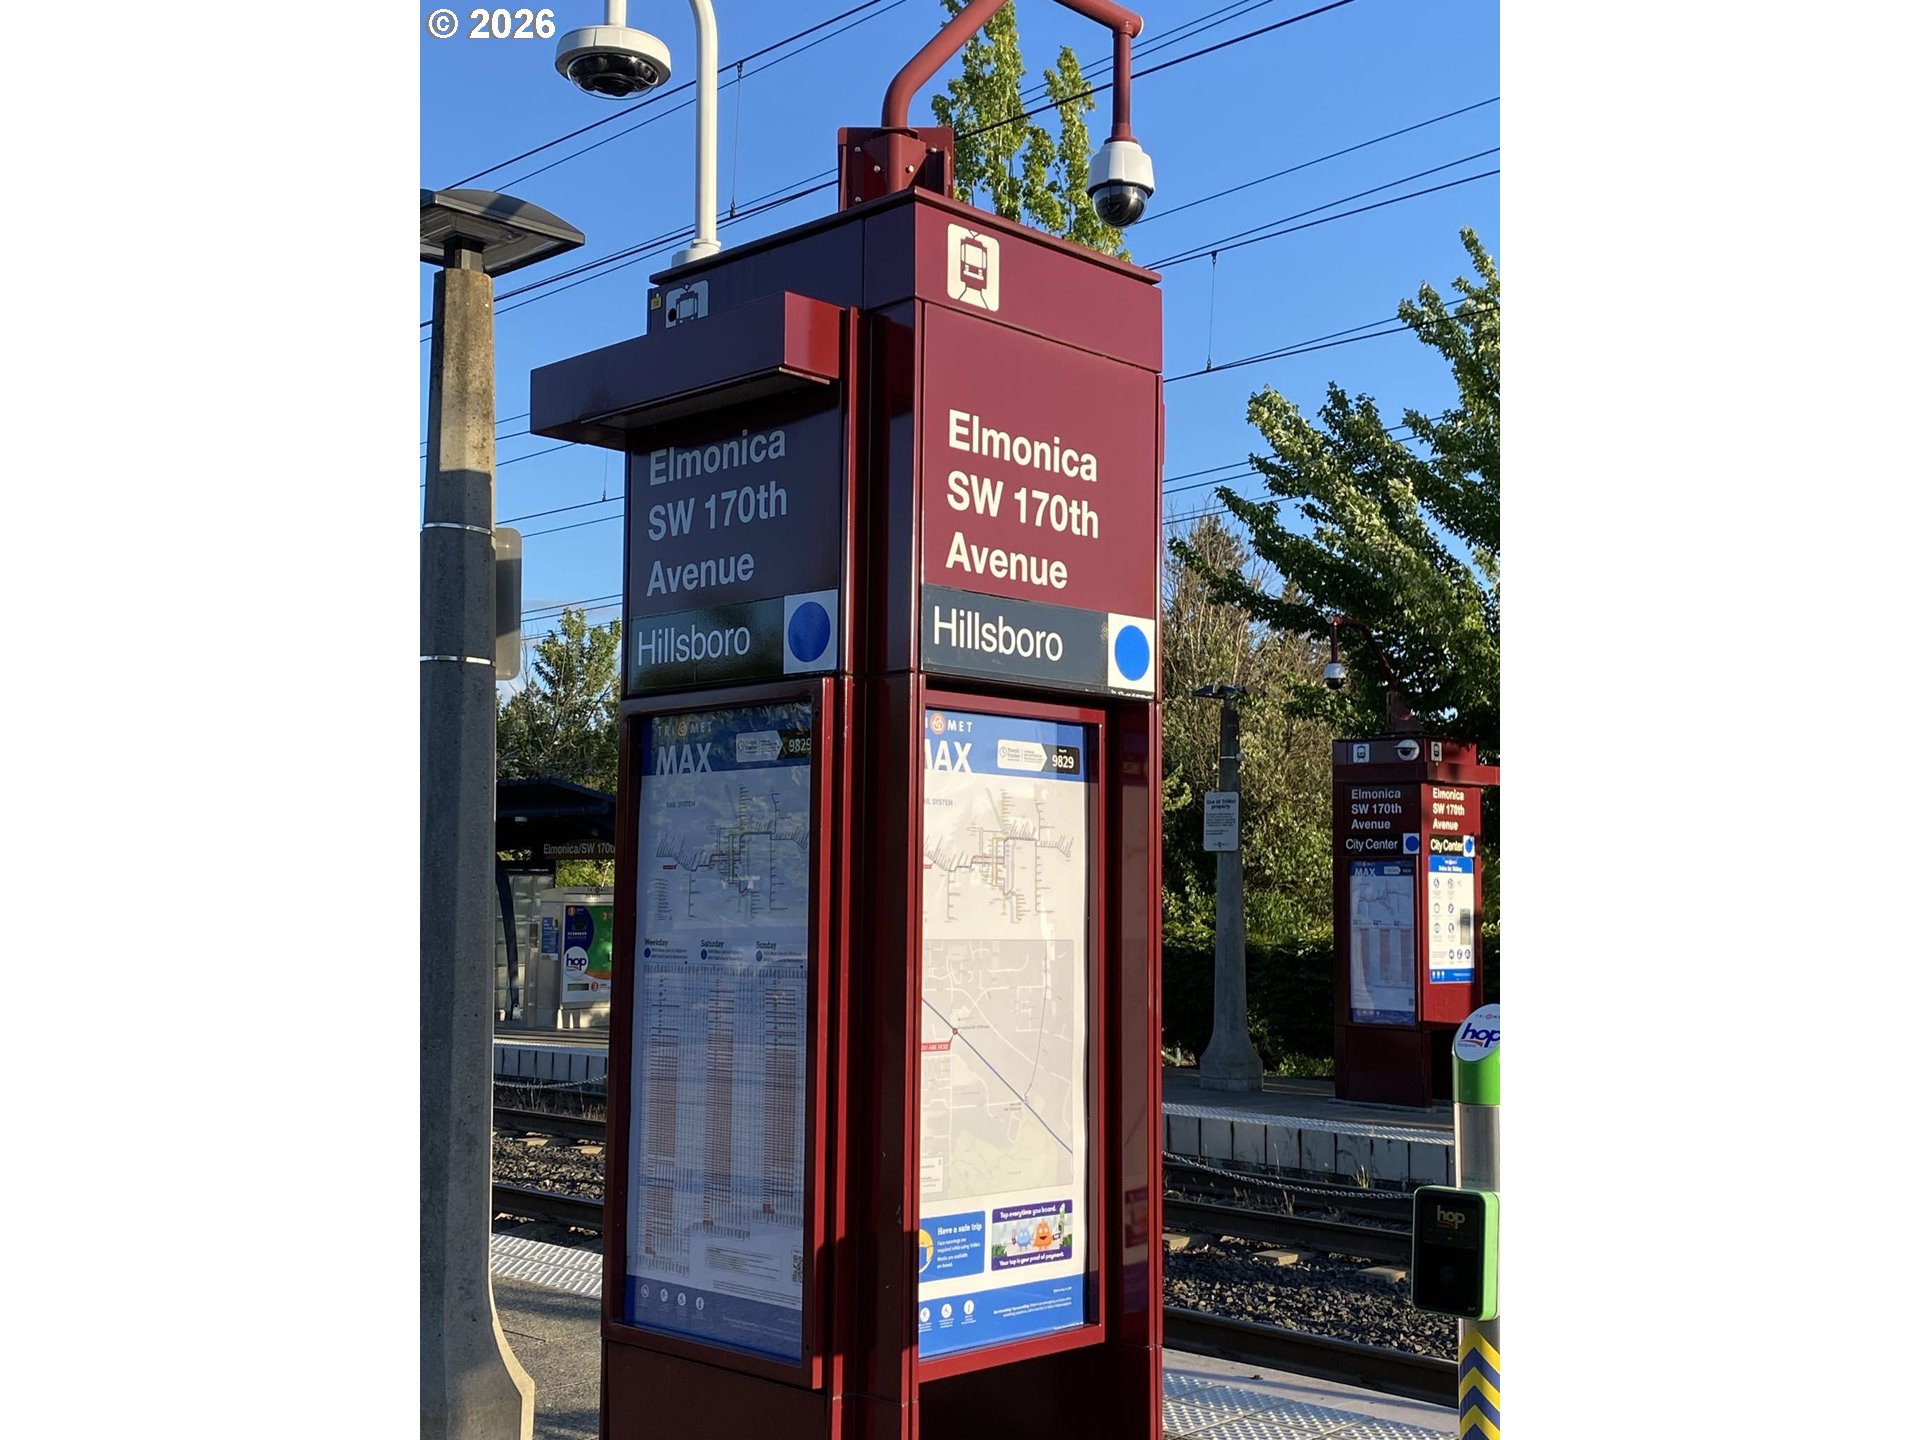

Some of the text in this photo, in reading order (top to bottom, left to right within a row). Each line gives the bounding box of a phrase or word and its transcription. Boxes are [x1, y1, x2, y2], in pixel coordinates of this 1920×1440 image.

[948, 408, 1098, 482] Elmonica
[648, 428, 786, 487] Elmonica
[647, 480, 787, 542] SW 170th
[946, 470, 1100, 539] SW 170th
[945, 531, 1068, 590] Avenue
[646, 552, 755, 597] Avenue
[933, 605, 1063, 662] Hillsboro
[637, 623, 751, 667] Hillsboro
[690, 721, 712, 734] MET
[947, 721, 973, 733] MET
[788, 737, 811, 753] 9829
[656, 742, 713, 775] MAX
[1052, 754, 1075, 769] 9829
[1351, 788, 1401, 799] Elmonica
[1432, 787, 1465, 801] Elmonica
[1351, 803, 1402, 815] SW 170th
[1432, 802, 1465, 816] SW 170th
[1351, 819, 1391, 830] Avenue
[1432, 818, 1459, 831] Avenue
[543, 842, 595, 855] Elmonica/SW
[1346, 838, 1398, 852] City Center
[1430, 838, 1464, 853] City Center
[1354, 867, 1376, 877] MAX
[566, 953, 587, 971] hop
[1461, 1022, 1500, 1048] hop
[1000, 1211, 1008, 1219] Tap
[1436, 1205, 1466, 1230] hop
[937, 1227, 952, 1235] Have
[958, 1224, 970, 1233] safe
[971, 1222, 982, 1232] trip
